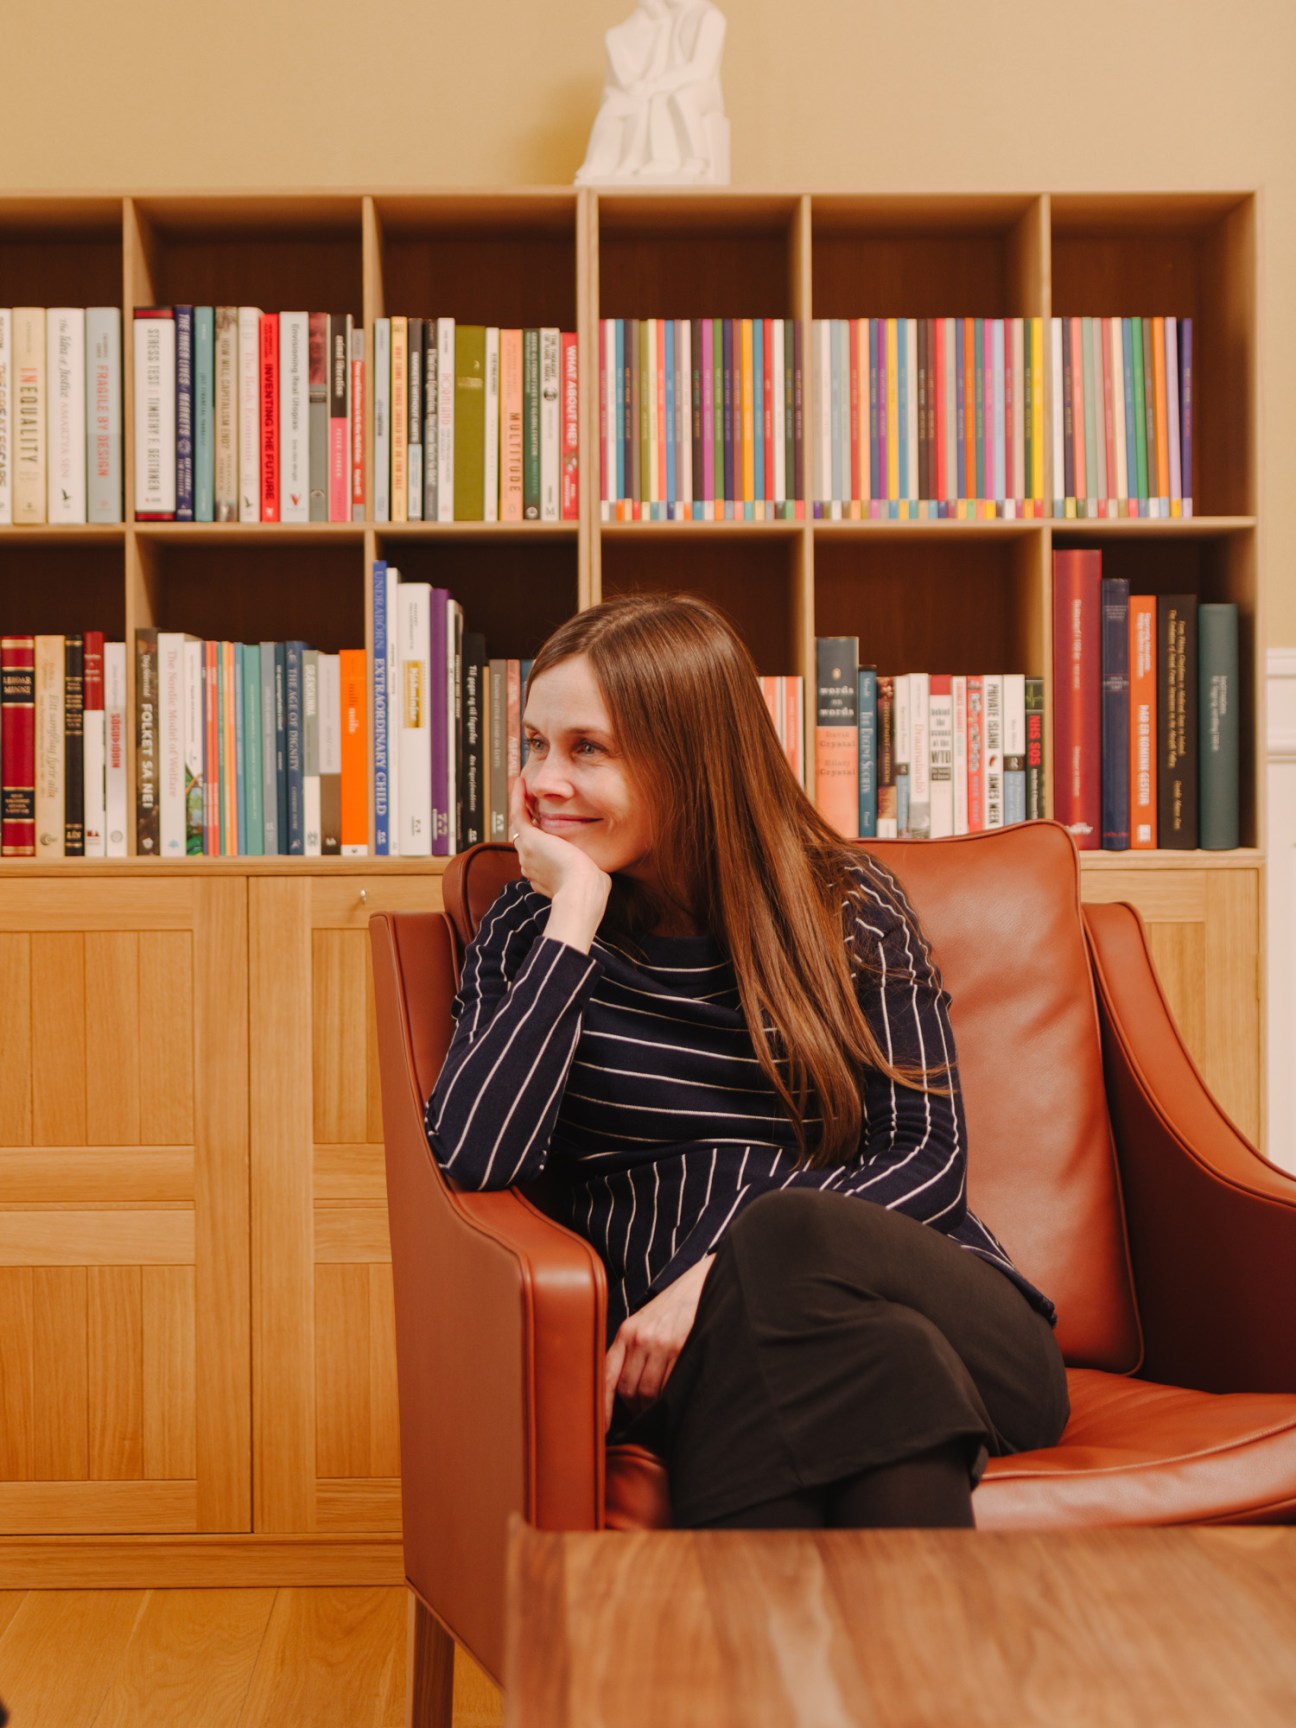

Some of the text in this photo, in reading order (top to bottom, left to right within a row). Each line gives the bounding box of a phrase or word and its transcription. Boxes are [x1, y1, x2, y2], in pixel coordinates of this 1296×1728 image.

[96, 365, 108, 412] FRAGILE
[148, 328, 160, 386] STRESS TEST
[290, 323, 300, 430] Envisioning Real Utopias
[335, 334, 344, 397] animal liberation
[19, 367, 38, 463] INEQUALITY
[96, 416, 108, 430] BY
[148, 397, 160, 434] TIMOTHY
[566, 345, 575, 448] WHAT ABOUT ME?
[96, 435, 108, 478] DESIGN
[264, 364, 273, 500] INVENTING THE FUTURE
[508, 412, 519, 492] MULTITUDE
[167, 650, 178, 798] The Nordic Model of Welfare
[288, 667, 297, 771] THE AGE OF DIGNITY
[374, 570, 386, 816] UNDRABÖRN EXTRAORDINARY CHILD
[988, 684, 999, 749] PRIVATE ISLAND
[142, 704, 152, 808] FOLKET SA NEI
[1028, 715, 1039, 739] NHS
[1028, 742, 1039, 766] SOS
[989, 772, 1000, 800] JAMES
